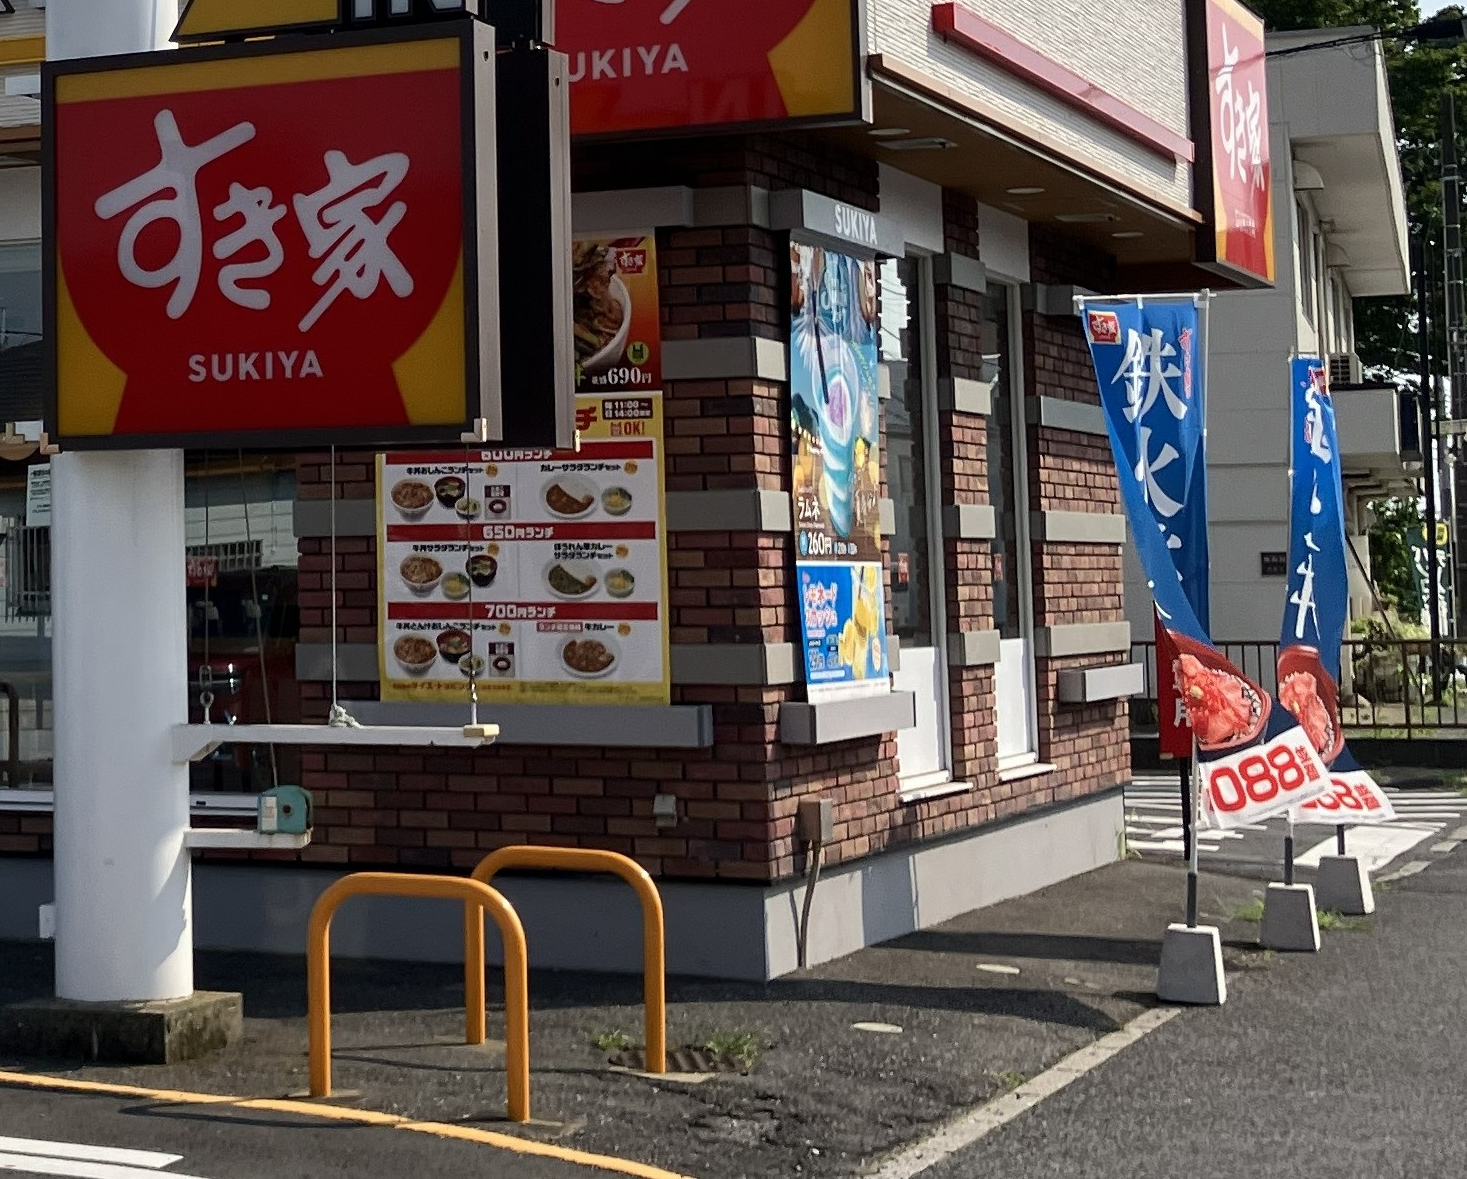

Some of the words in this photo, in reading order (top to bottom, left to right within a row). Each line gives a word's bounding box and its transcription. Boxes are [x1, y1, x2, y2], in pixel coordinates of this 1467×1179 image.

[569, 43, 689, 82] UKIYA
[94, 109, 414, 332] すき家
[835, 204, 878, 245] SUKIYA
[188, 350, 323, 383] SUKIYA
[798, 495, 821, 521] ラムネ
[483, 525, 554, 539] 650円ランチ
[807, 532, 832, 556] 260円
[484, 604, 556, 619] 700円ランチ
